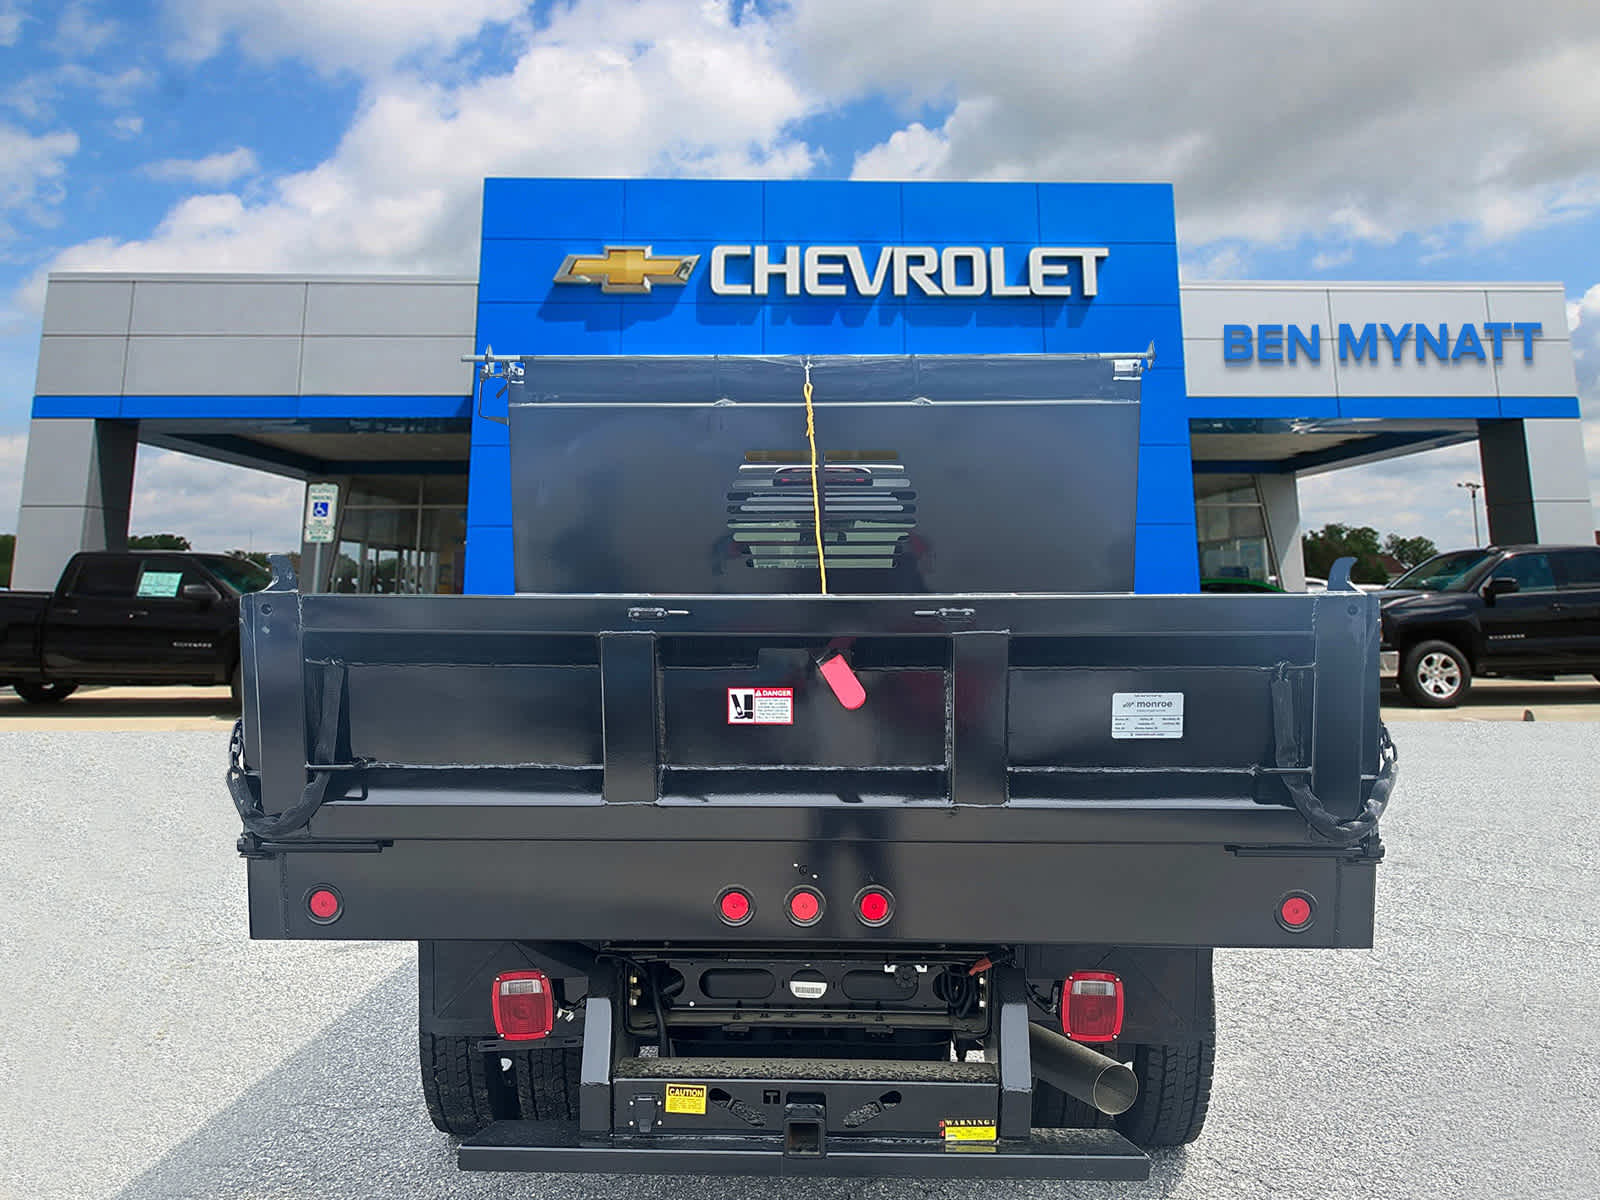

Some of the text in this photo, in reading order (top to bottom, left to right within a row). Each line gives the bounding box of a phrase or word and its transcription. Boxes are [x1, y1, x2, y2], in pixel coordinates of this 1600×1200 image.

[710, 245, 1109, 296] CHEVROLET
[1223, 322, 1543, 363] BEN MYNATT
[762, 689, 792, 697] DANGER
[1136, 700, 1173, 708] monroe
[668, 1088, 704, 1097] CAUTION
